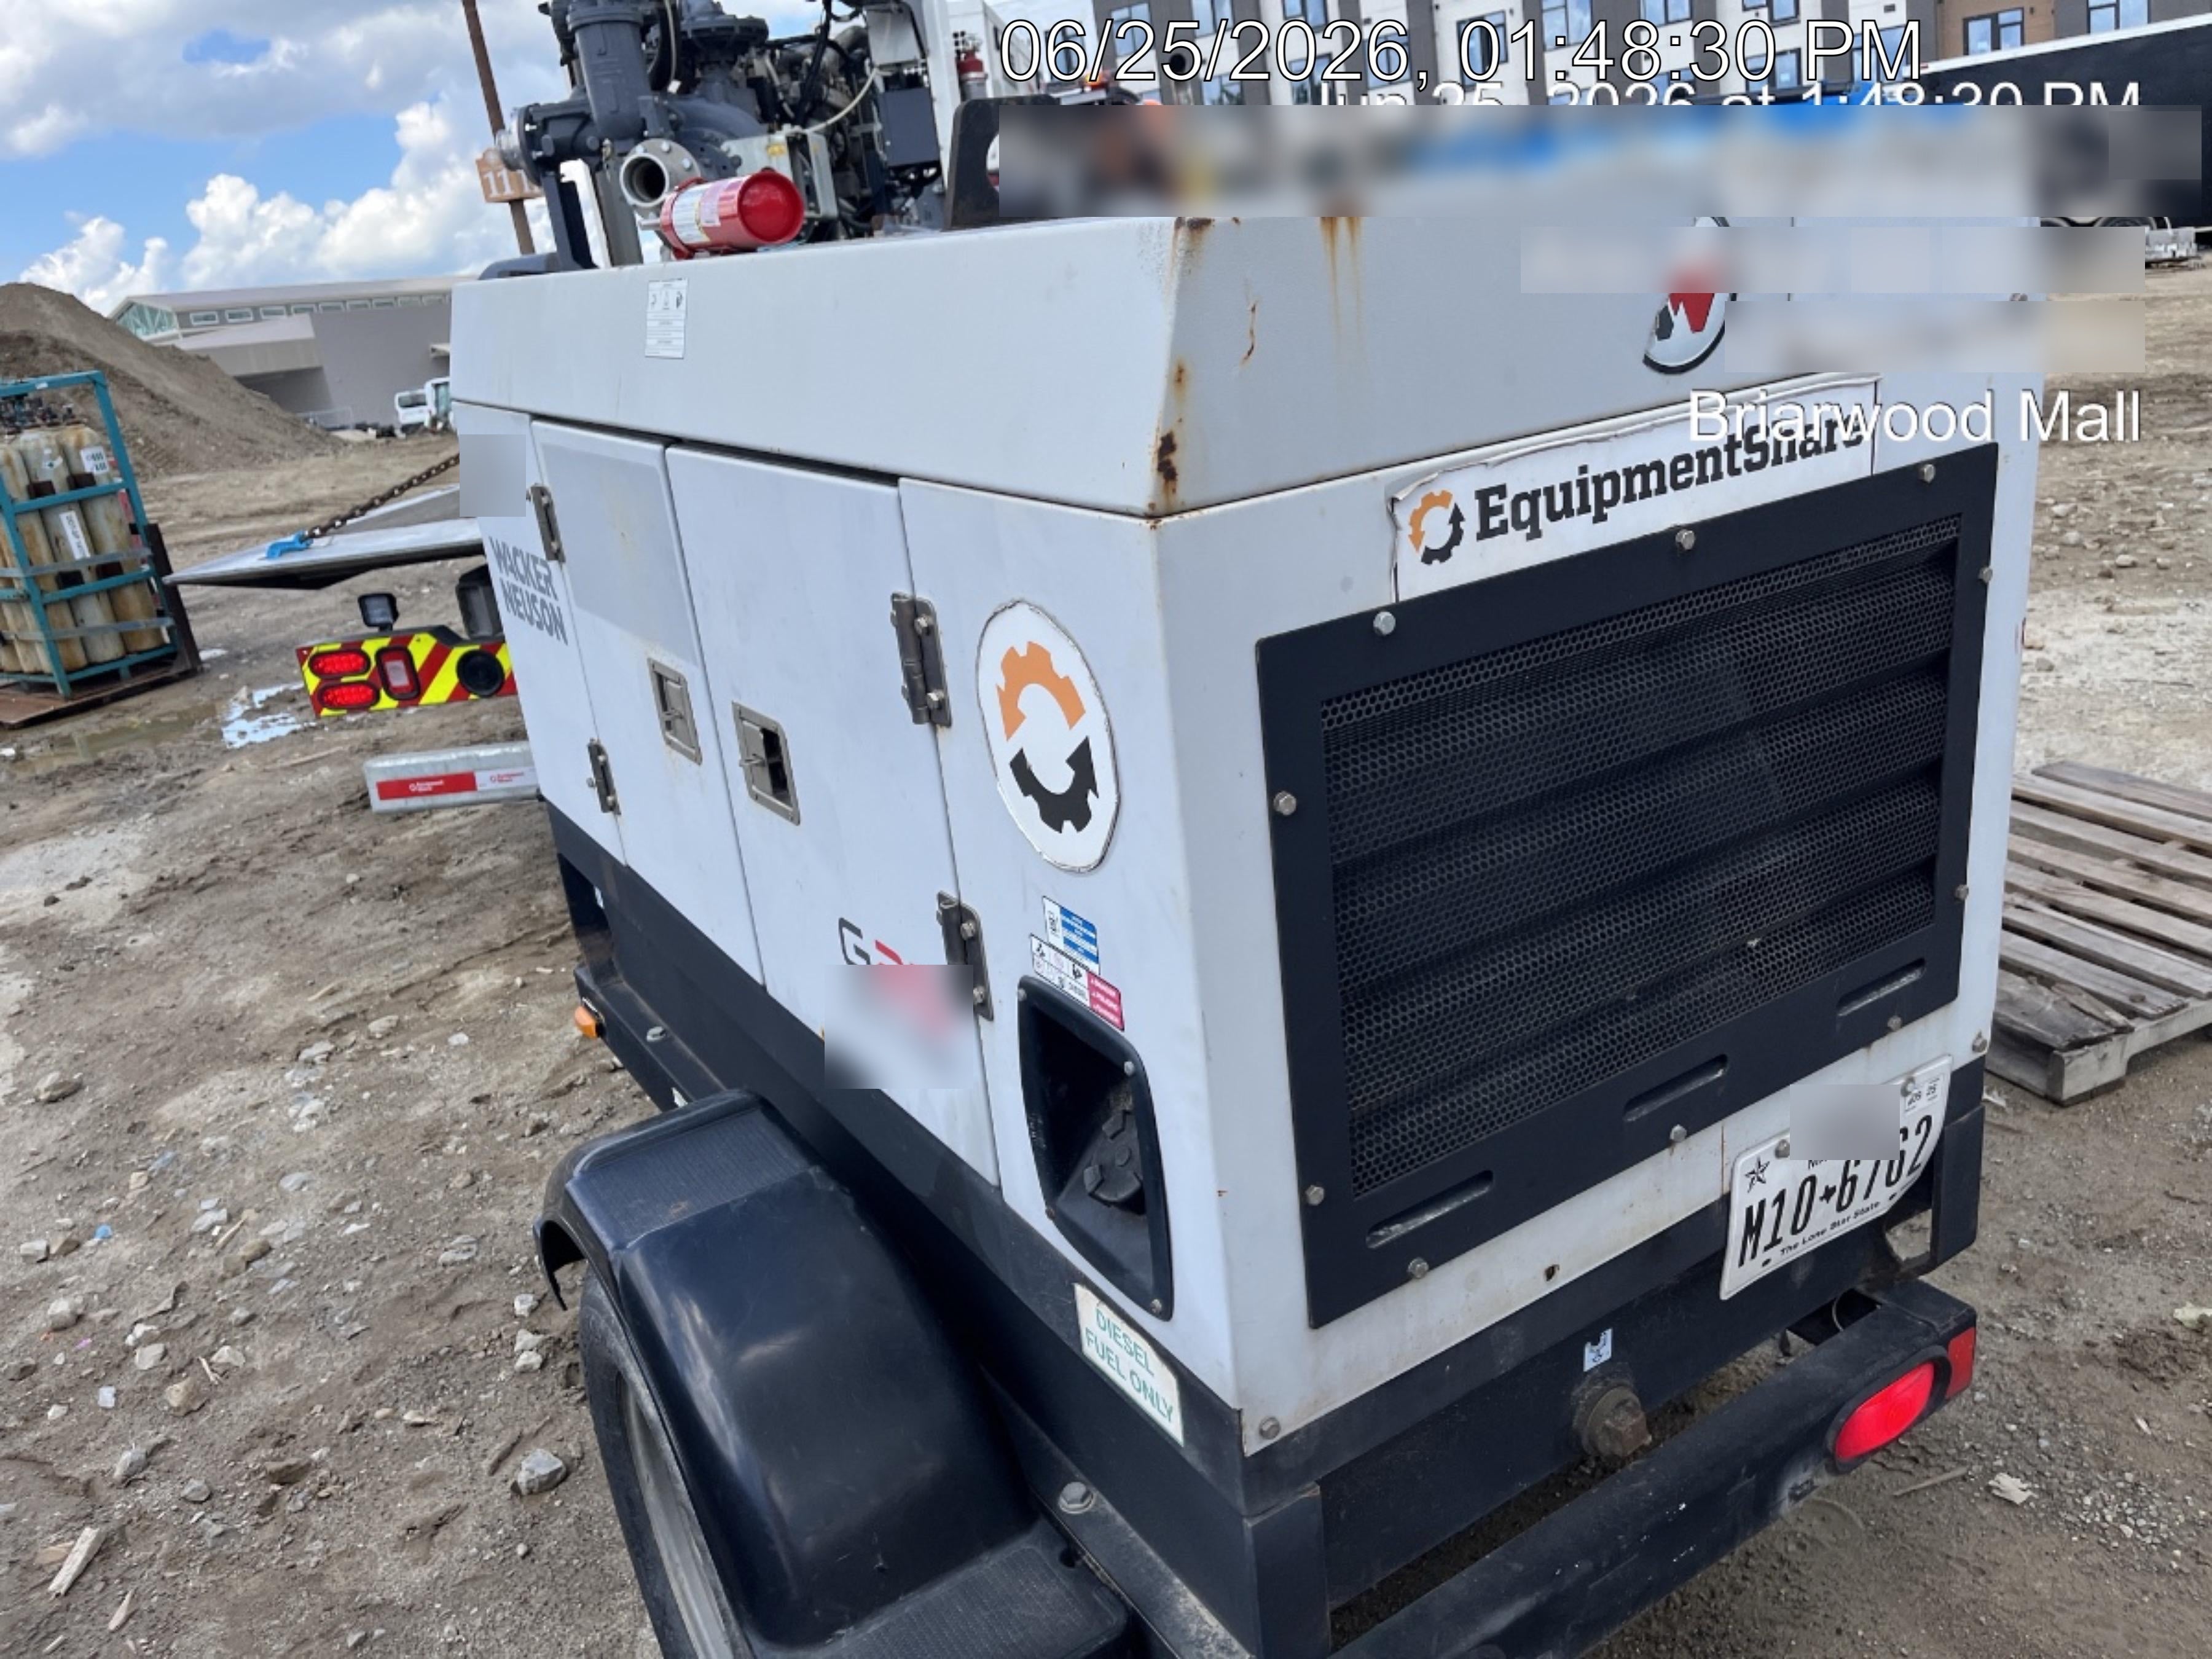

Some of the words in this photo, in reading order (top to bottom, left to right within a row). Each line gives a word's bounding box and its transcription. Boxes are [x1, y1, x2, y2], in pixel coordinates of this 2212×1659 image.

[1475, 413, 1864, 542] EquipmentShare
[488, 536, 559, 601] WACKER
[500, 577, 568, 645] NEUSON
[1085, 1326, 1126, 1381] FUEL
[1129, 1368, 1173, 1422] ONLY
[1095, 1308, 1155, 1377] DIESEL
